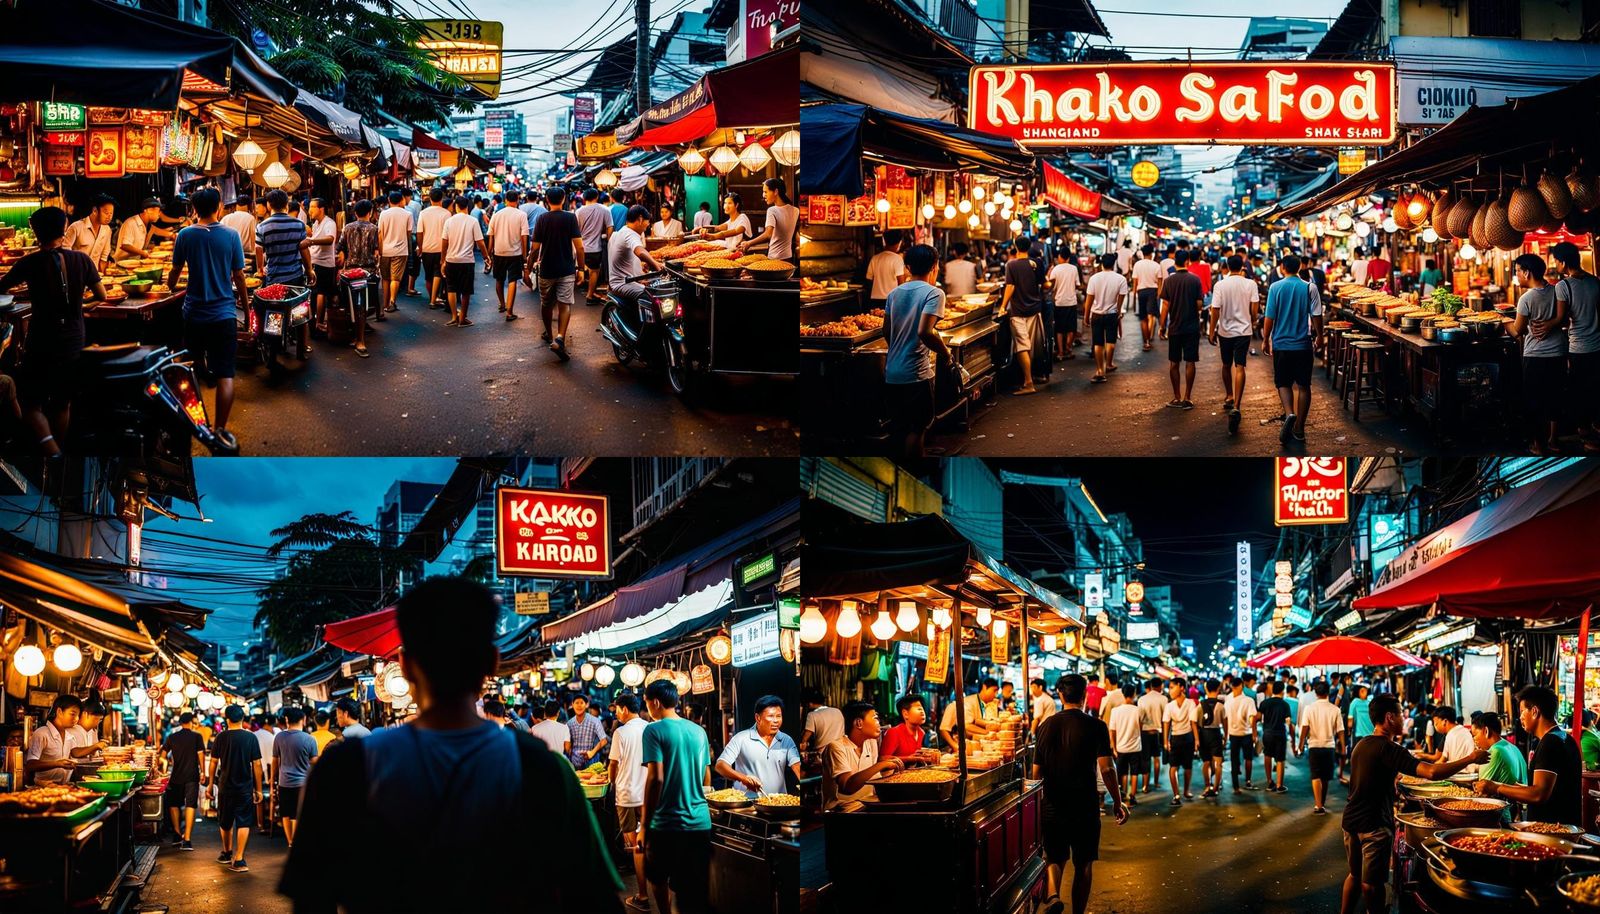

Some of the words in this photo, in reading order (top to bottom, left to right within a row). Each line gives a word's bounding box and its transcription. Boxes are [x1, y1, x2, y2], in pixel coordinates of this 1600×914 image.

[983, 69, 1162, 127] Khako
[1174, 69, 1380, 123] SaFod
[1305, 127, 1341, 138] SHAK
[510, 499, 598, 529] KAKKO
